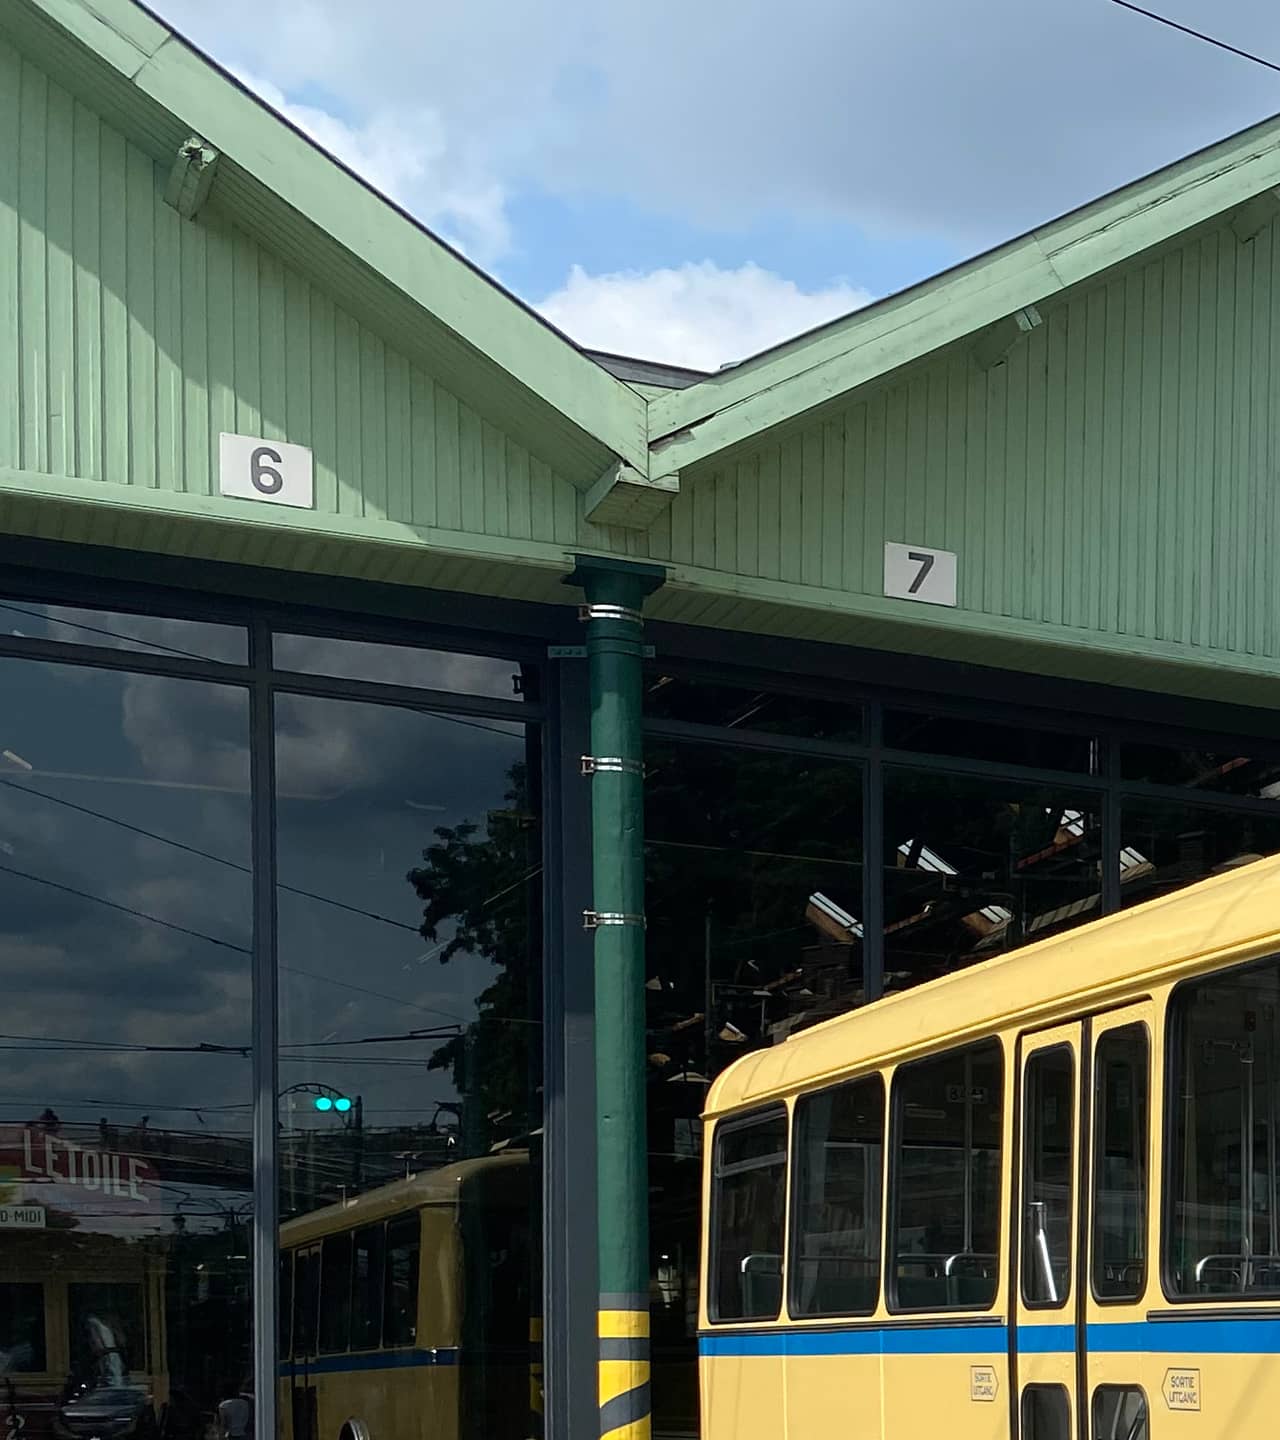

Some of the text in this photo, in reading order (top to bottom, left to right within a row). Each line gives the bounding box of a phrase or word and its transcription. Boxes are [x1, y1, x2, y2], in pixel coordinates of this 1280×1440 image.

[250, 446, 284, 496] 6
[907, 551, 936, 596] 7
[1170, 1375, 1195, 1389] SORTIE
[1168, 1391, 1198, 1404] UITGANG
